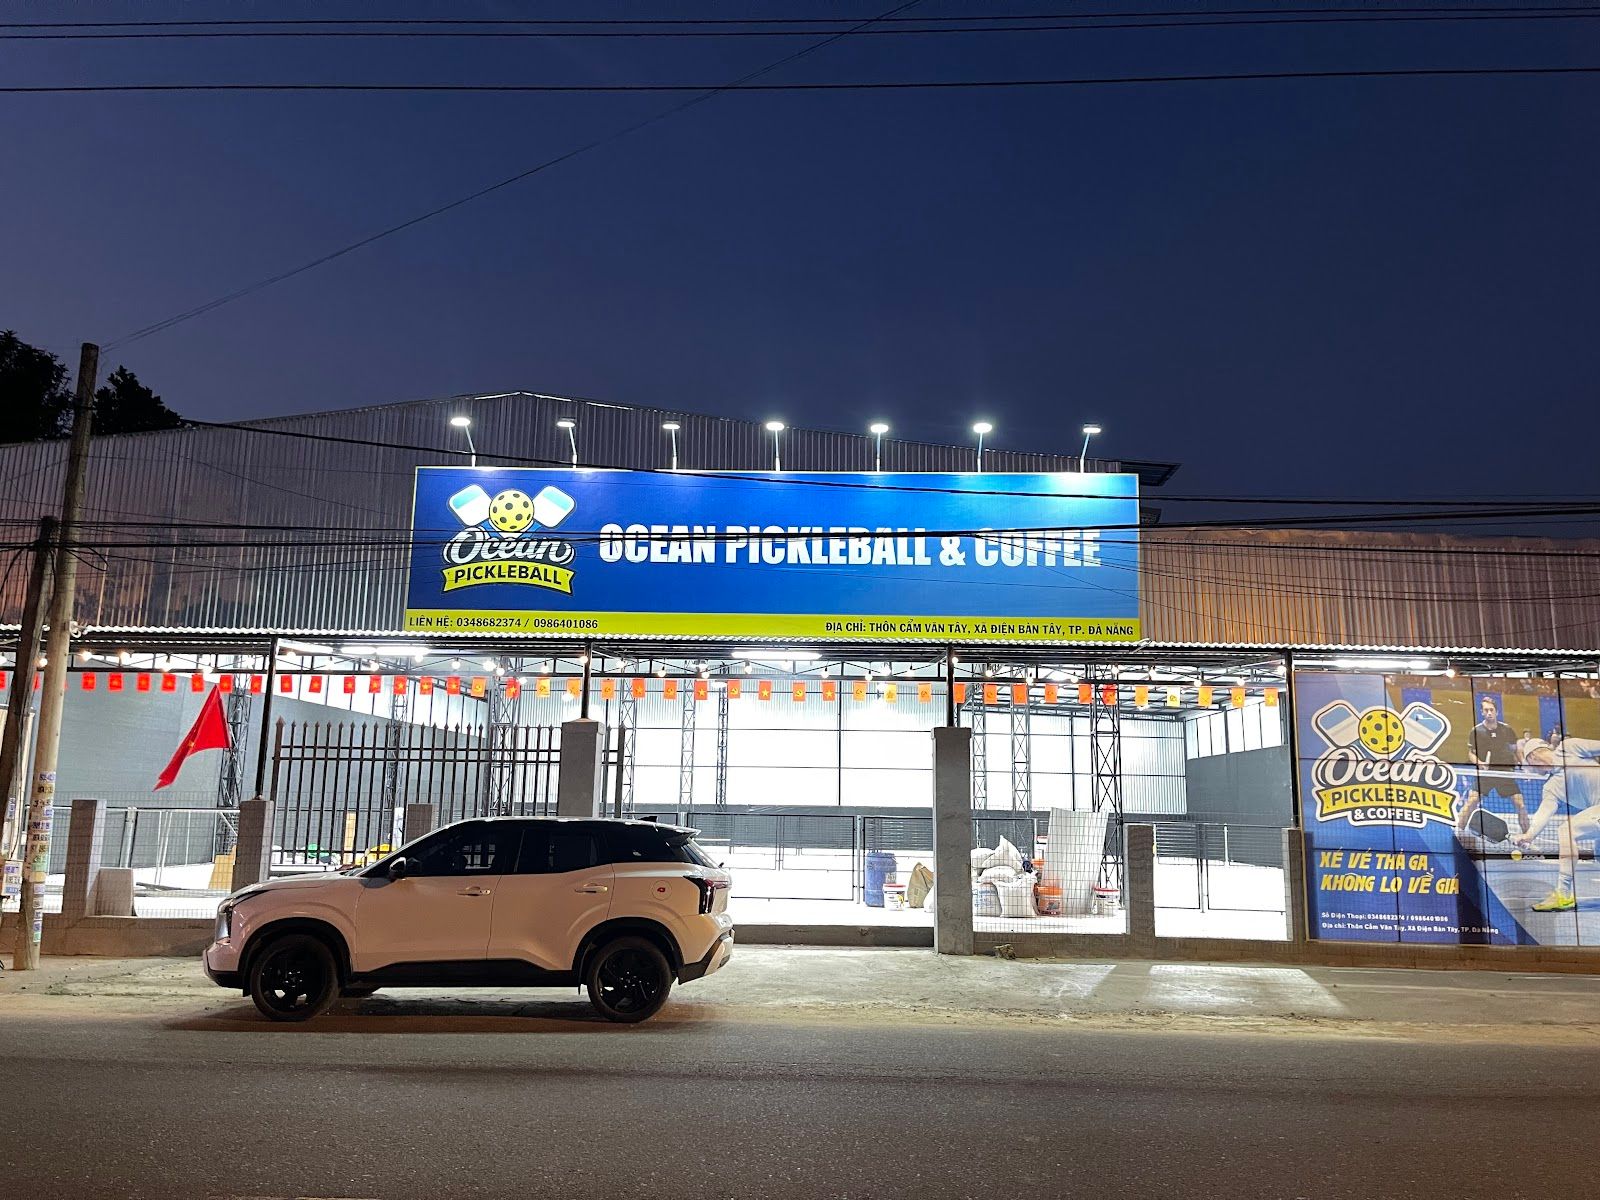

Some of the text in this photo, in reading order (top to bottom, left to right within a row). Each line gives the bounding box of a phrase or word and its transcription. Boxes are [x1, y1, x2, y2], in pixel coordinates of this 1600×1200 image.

[443, 526, 575, 565] Ocean
[599, 523, 1102, 567] OCEAN PICKLEBALL & COFFEE
[454, 565, 562, 586] PICKLEBALL
[409, 615, 433, 627] LIÊN
[436, 615, 453, 629] HỆ:
[456, 617, 522, 628] 0348682374
[533, 618, 599, 629] 0986401086
[825, 621, 843, 634] ĐỊA
[869, 620, 897, 632] THÔN
[899, 618, 922, 633] CẨM
[948, 621, 971, 635] TÂY,
[990, 622, 1015, 636] ĐIỆN
[1043, 622, 1066, 636] TÂY,
[1068, 625, 1085, 635] TP.
[1318, 747, 1451, 788] Ocean
[1331, 787, 1442, 810] PICKLEBALL
[1354, 807, 1421, 821] & COFFEE
[1319, 846, 1344, 868] XÉ
[1347, 847, 1372, 869] VÉ
[1320, 871, 1460, 895] KHÔNG LO VỀ GIÁ
